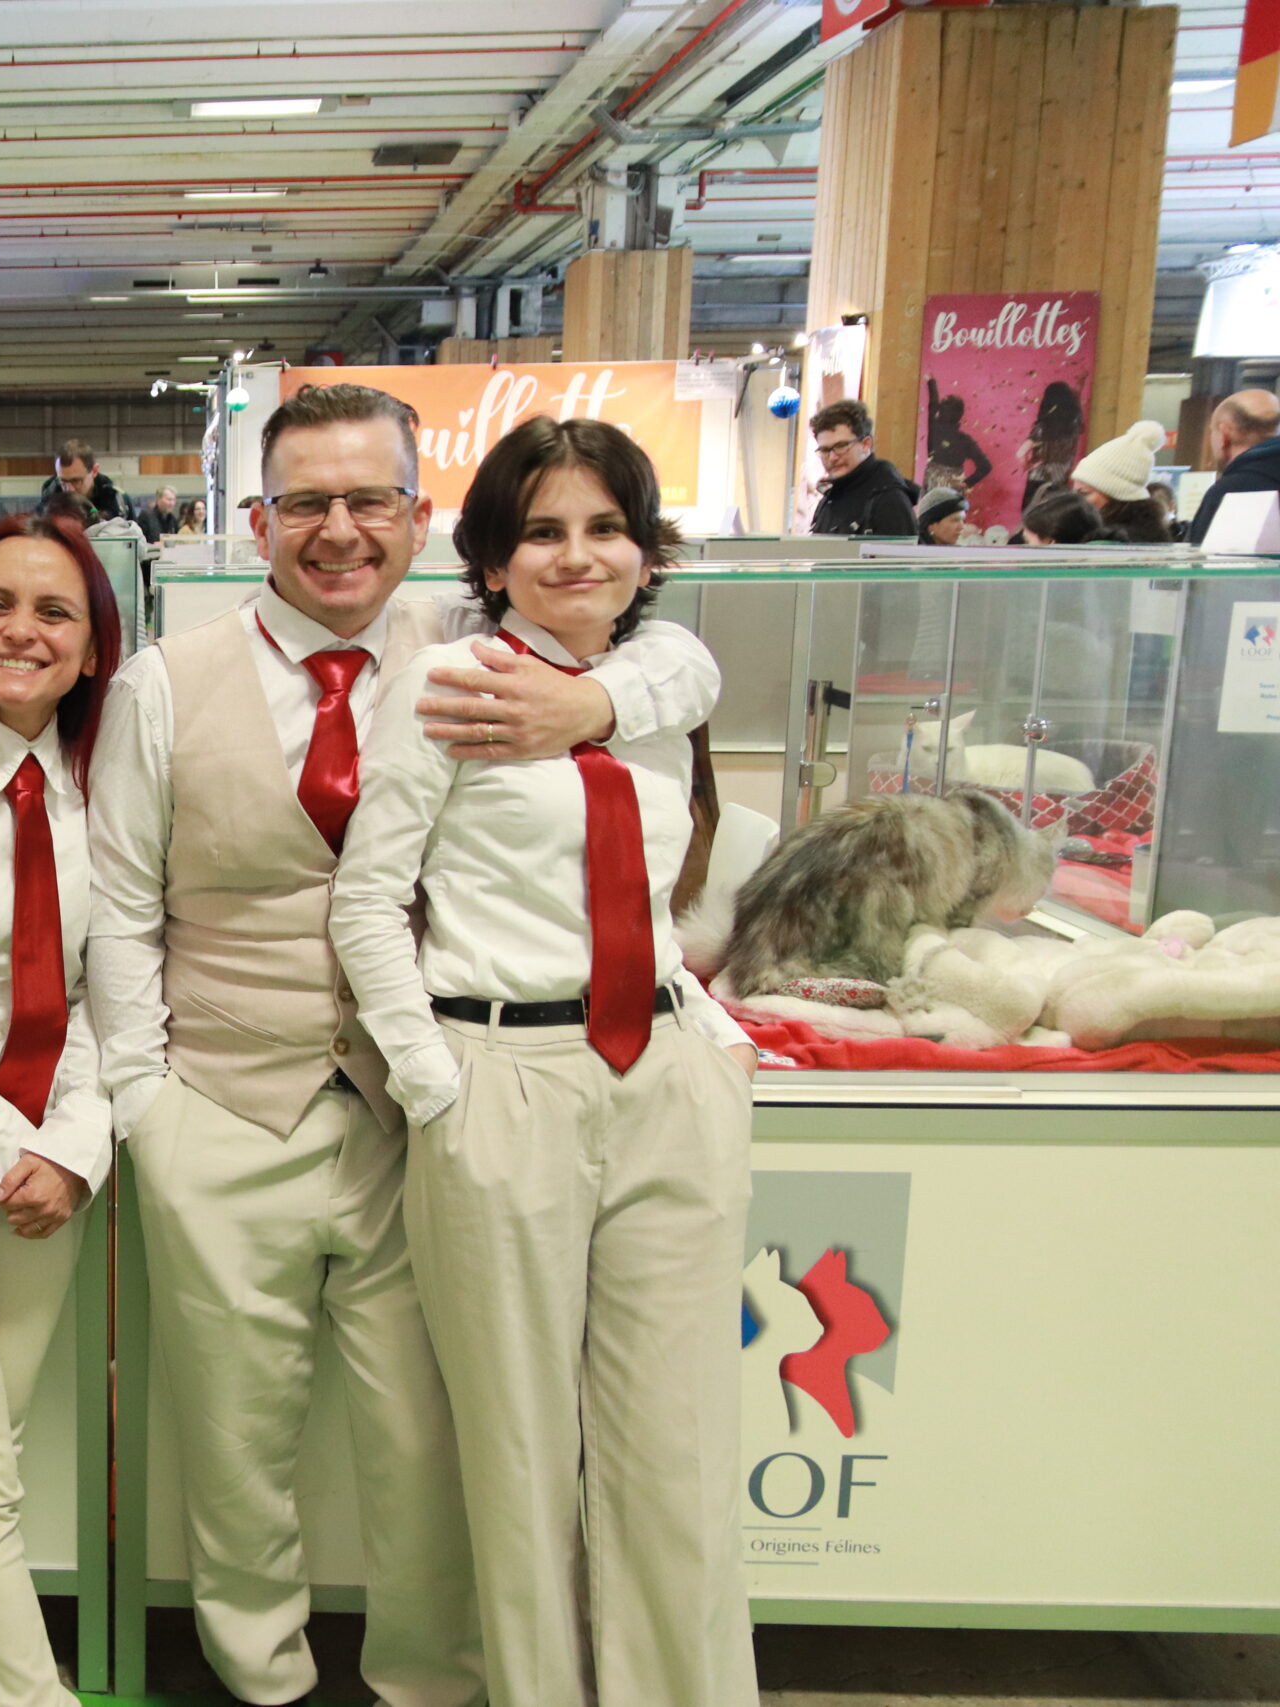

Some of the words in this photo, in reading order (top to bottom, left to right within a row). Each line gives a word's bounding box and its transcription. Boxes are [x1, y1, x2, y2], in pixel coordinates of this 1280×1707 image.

[931, 300, 1087, 356] Bouillottes
[750, 1537, 820, 1556] Origines
[825, 1538, 881, 1555] Félines
